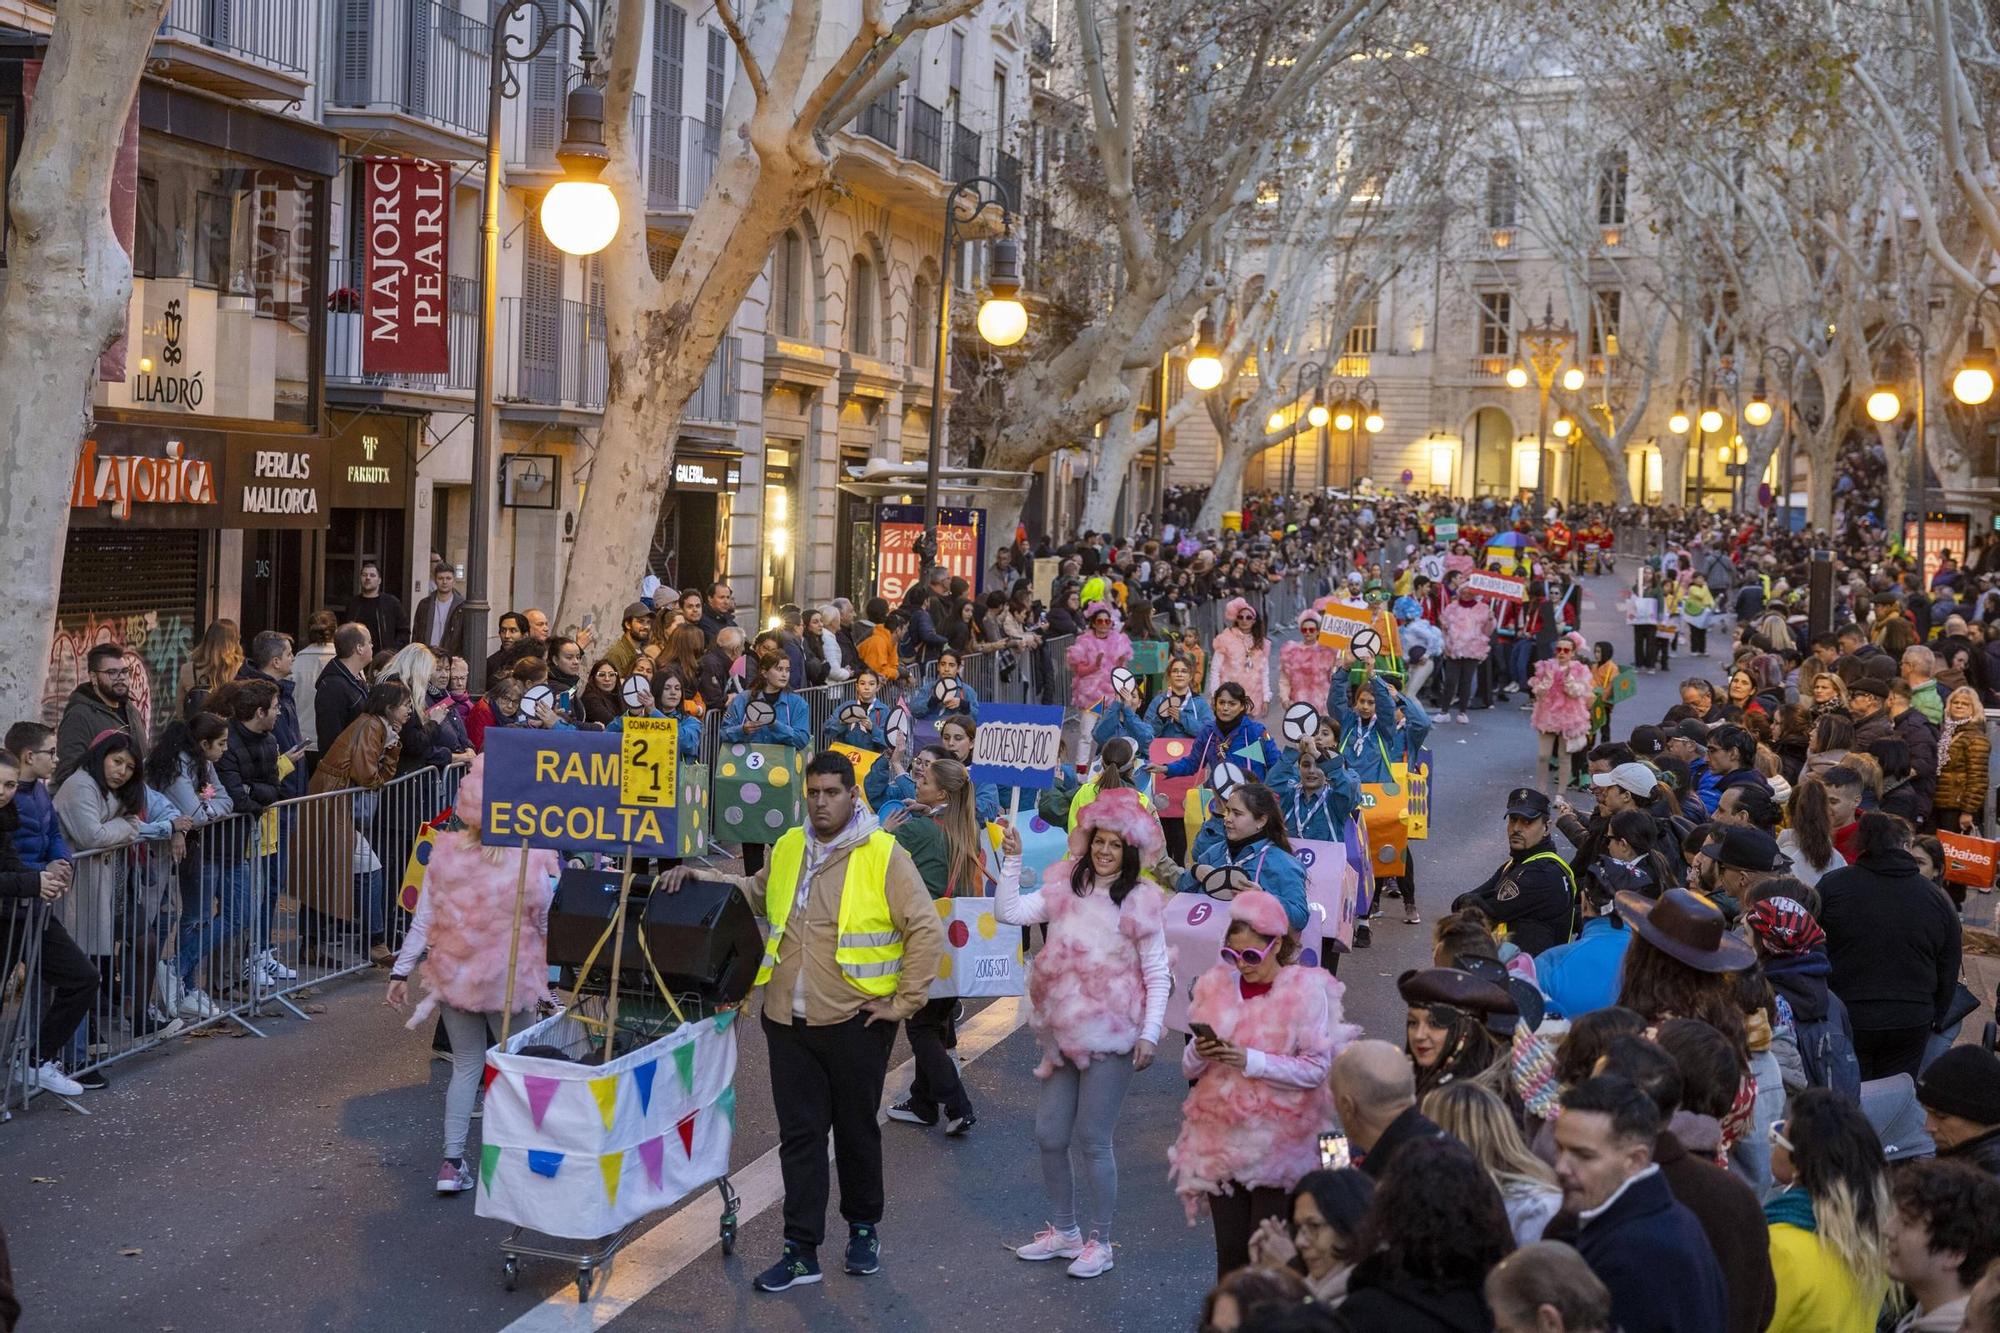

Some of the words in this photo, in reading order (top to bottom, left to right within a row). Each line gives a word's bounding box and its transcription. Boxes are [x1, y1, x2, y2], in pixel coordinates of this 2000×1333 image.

[371, 156, 408, 343] MAJORC
[136, 371, 203, 411] LLADRÓ
[255, 451, 310, 480] PERLAS
[243, 487, 318, 514] MALLORCA
[628, 720, 672, 731] COMPARSA
[751, 755, 760, 767] 3
[1361, 794, 1376, 807] 12
[490, 801, 665, 844] ESCOLTA
[1191, 904, 1208, 922] 5
